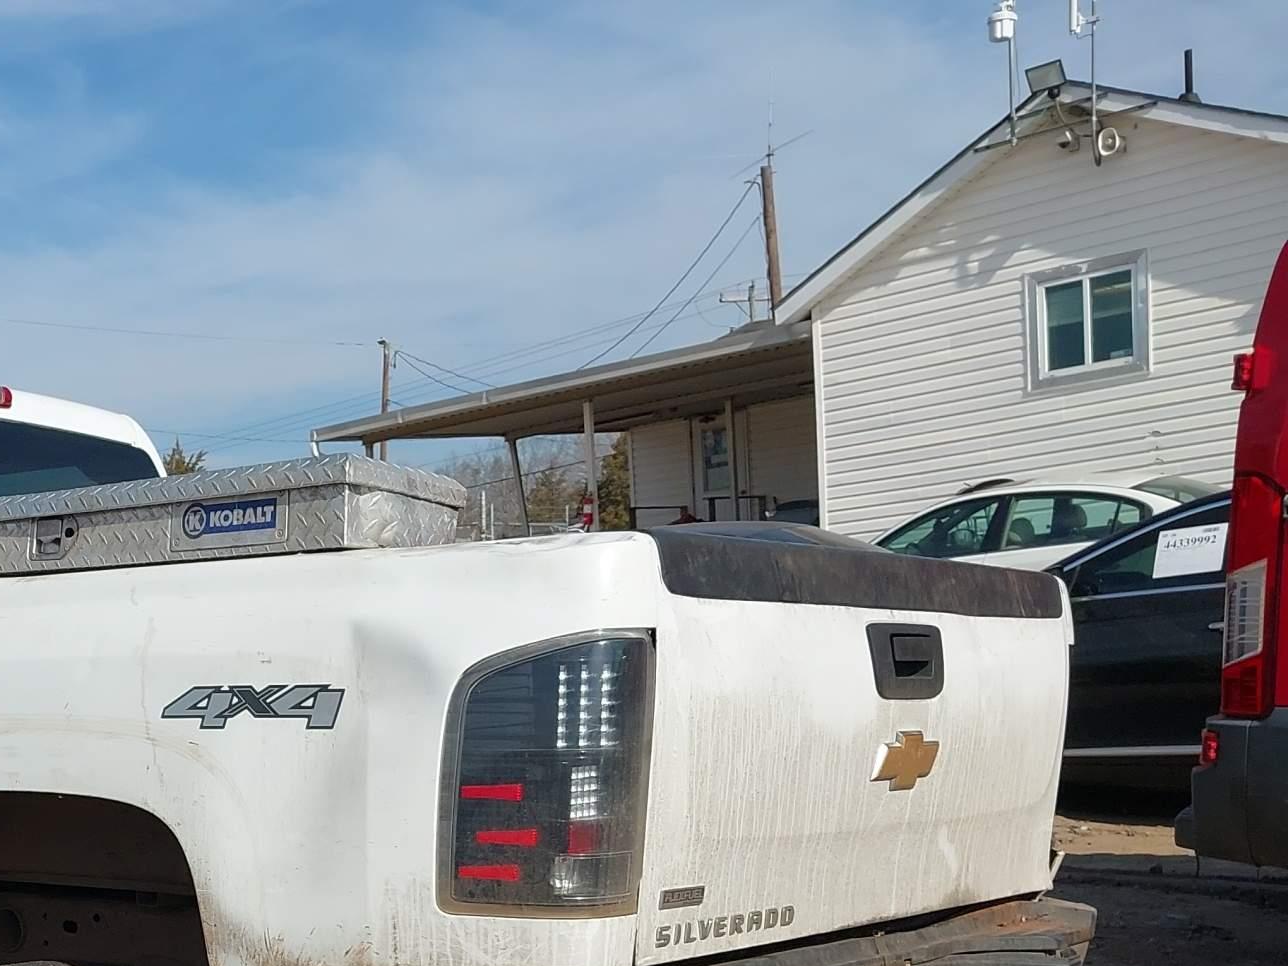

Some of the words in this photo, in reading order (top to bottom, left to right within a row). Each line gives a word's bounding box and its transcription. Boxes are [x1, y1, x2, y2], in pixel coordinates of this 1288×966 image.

[210, 505, 274, 527] KOBALT
[1163, 534, 1217, 549] 44339992
[655, 906, 795, 949] SILVERADO
